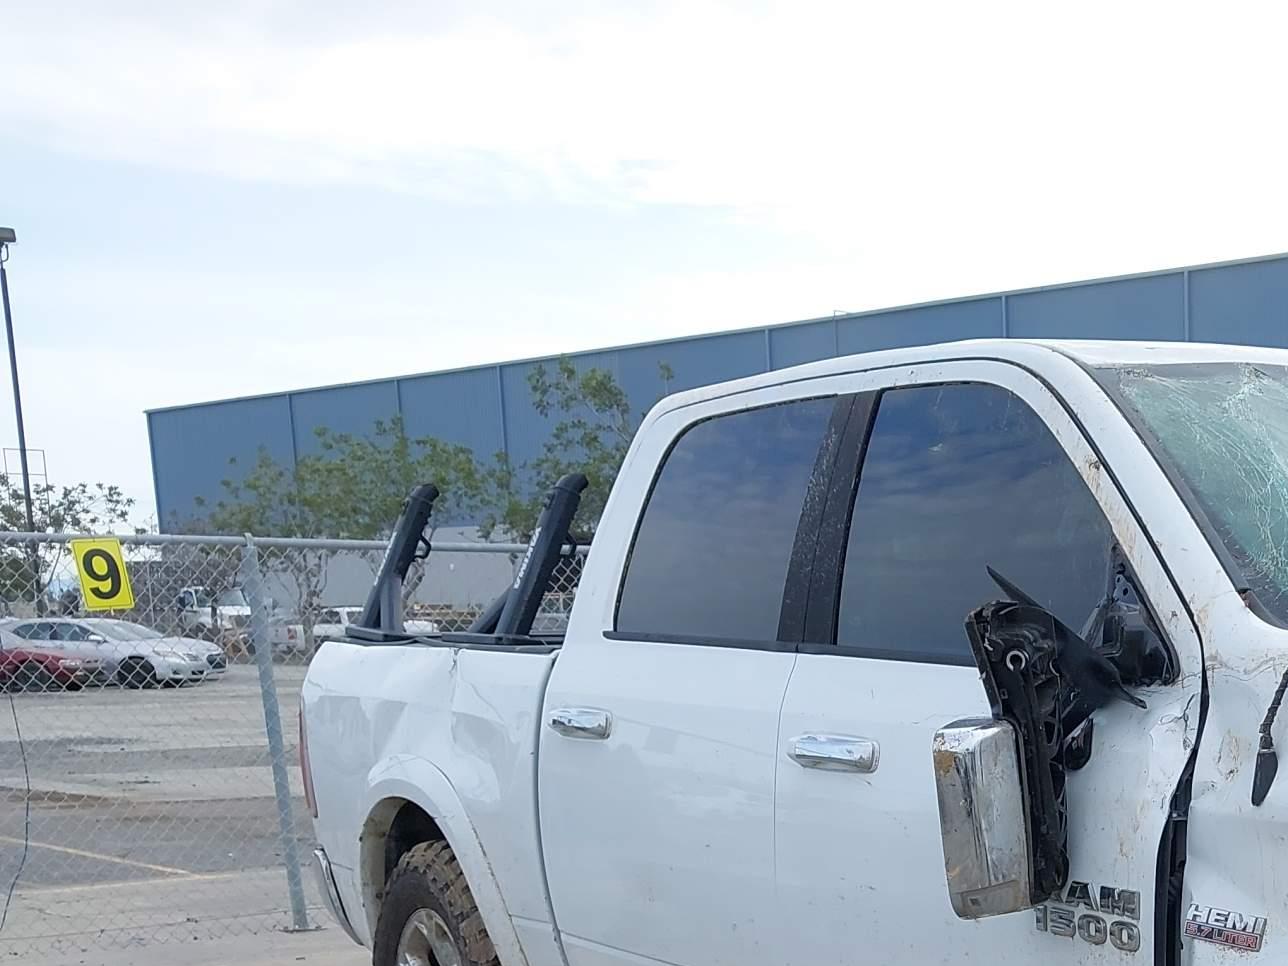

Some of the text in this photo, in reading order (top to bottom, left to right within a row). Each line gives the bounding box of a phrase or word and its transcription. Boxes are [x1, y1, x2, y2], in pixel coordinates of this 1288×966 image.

[83, 549, 121, 599] 9
[1034, 904, 1141, 953] 1500
[1186, 903, 1267, 934] HEMI
[1186, 922, 1256, 948] 5.7 LITER
